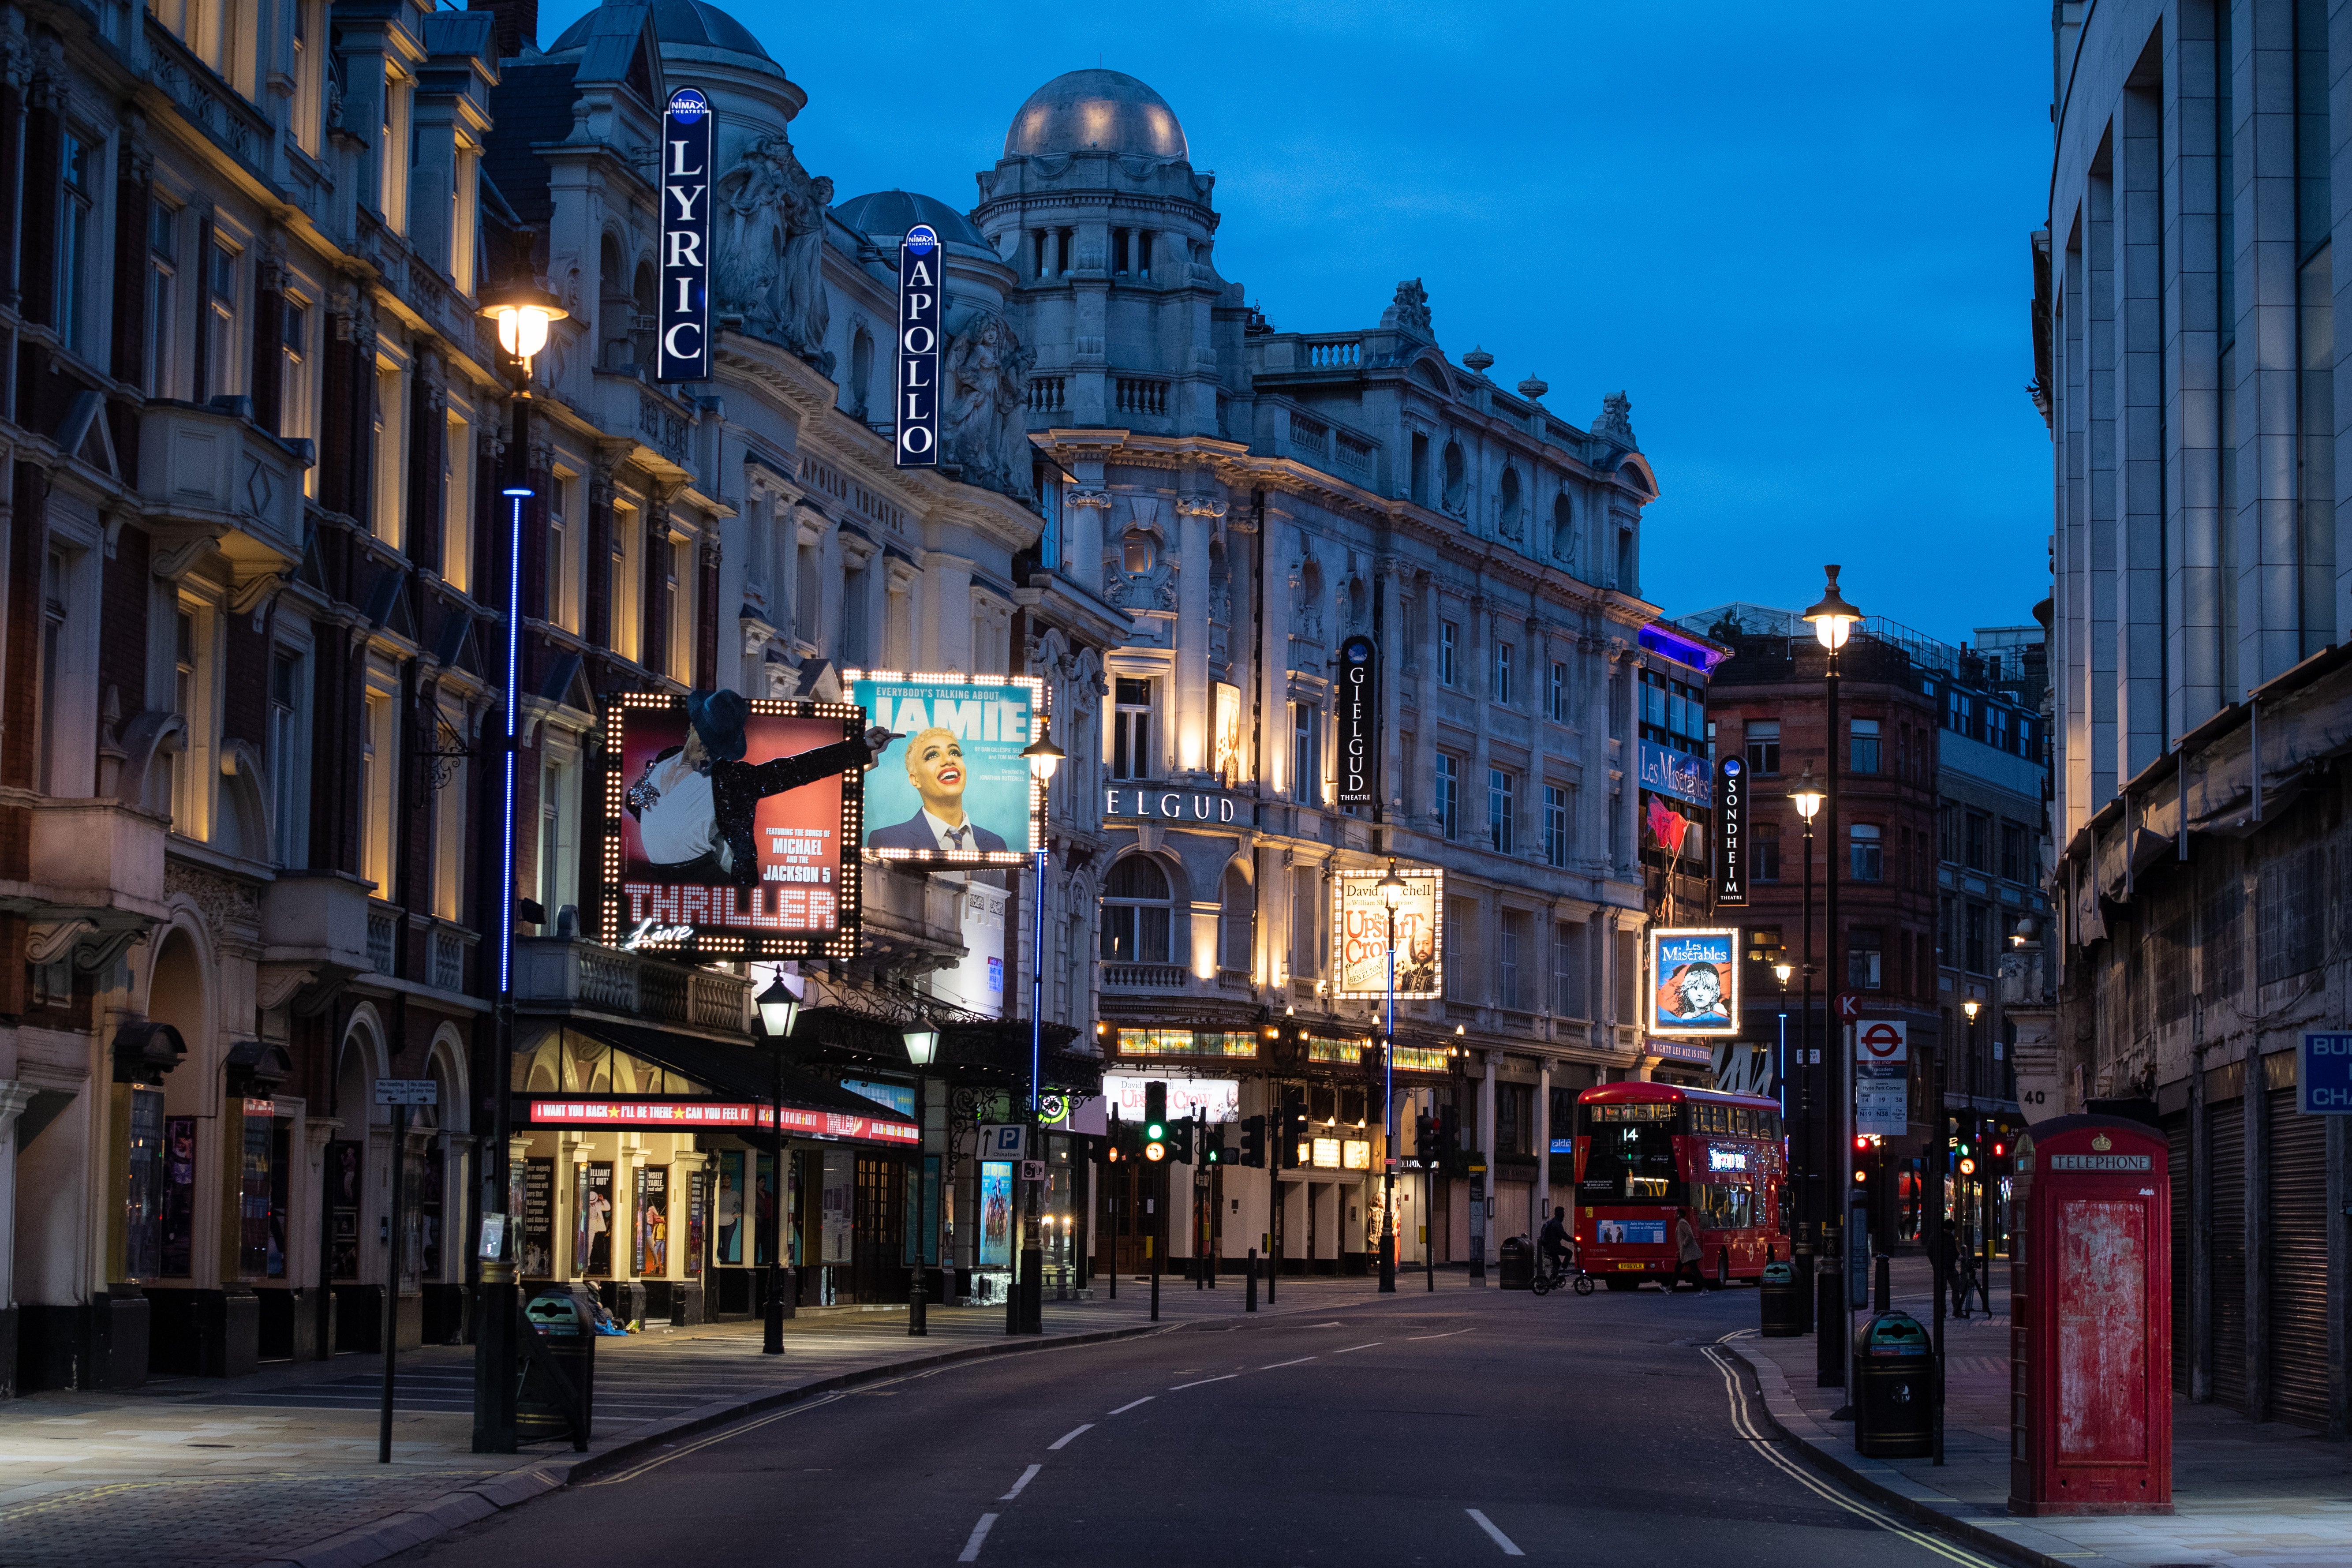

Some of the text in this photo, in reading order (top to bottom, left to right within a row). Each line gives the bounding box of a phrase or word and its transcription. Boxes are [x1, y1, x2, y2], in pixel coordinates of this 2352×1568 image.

[665, 140, 706, 359] LYRIC
[902, 261, 934, 453] APOLLO
[802, 457, 905, 535] APOLLO THEATRE
[876, 687, 999, 700] EVERYBODY'S TALKING ABOUT
[867, 697, 1026, 742] JAMIE
[1349, 667, 1364, 791] GIELGUD
[1641, 745, 1708, 800] Les Misérables
[766, 827, 793, 836] FEATURING
[1726, 779, 1738, 892] SONDHEIM
[773, 838, 823, 855] MICHAEL
[763, 865, 830, 883] JACKSON 5
[1346, 884, 1378, 897] David
[625, 884, 834, 928] THRILLER
[625, 917, 694, 950] Live
[1662, 946, 1727, 961] Misérables
[1686, 940, 1701, 951] Les
[1350, 974, 1361, 982] BEN
[1362, 963, 1380, 978] ELTON
[1843, 997, 1857, 1014] K
[1692, 1049, 1696, 1058] IS
[1697, 1050, 1709, 1060] STILL
[2024, 1091, 2045, 1104] 40
[2313, 1088, 2352, 1105] CH
[538, 1104, 749, 1120] I WANT YOU BACK I'LL BE THERE CAN YOU FEEL IT
[1624, 1128, 1638, 1141] 14
[2055, 1156, 2147, 1169] TELEPHONE
